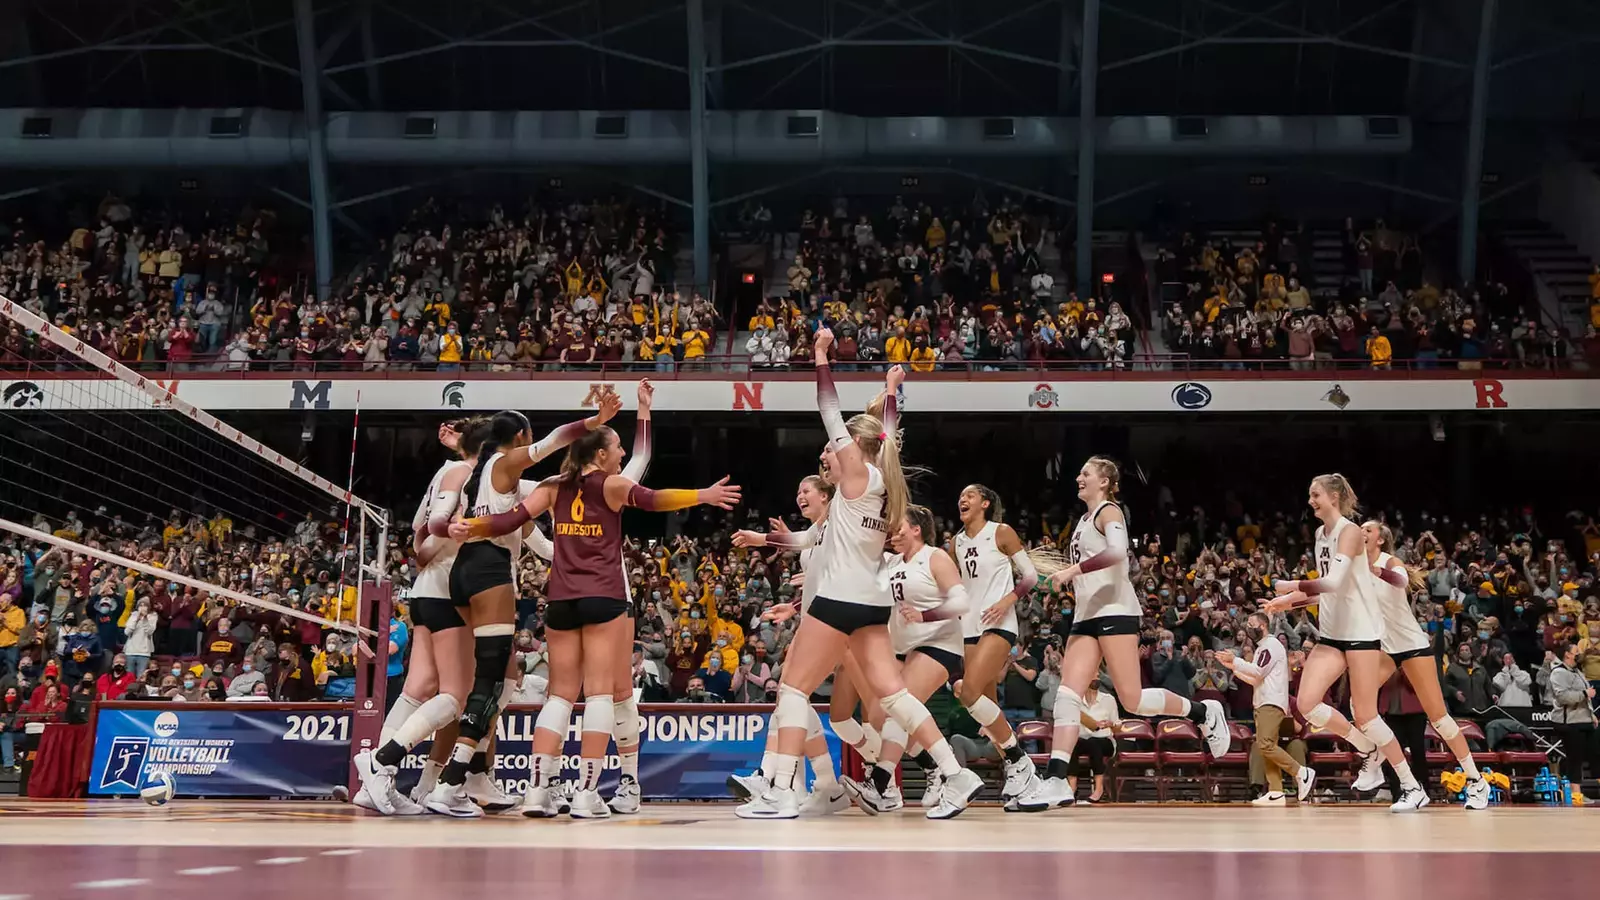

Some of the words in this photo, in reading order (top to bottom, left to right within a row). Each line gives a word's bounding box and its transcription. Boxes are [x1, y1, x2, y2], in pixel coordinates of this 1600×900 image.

[290, 380, 332, 410] M
[733, 382, 764, 410] N
[1473, 379, 1508, 408] R
[965, 560, 978, 579] 12
[891, 583, 905, 602] 13
[1532, 711, 1552, 721] mol
[283, 715, 349, 740] 2021
[148, 746, 229, 763] VOLLEYBALL
[144, 763, 216, 775] CHAMPIONSHIP
